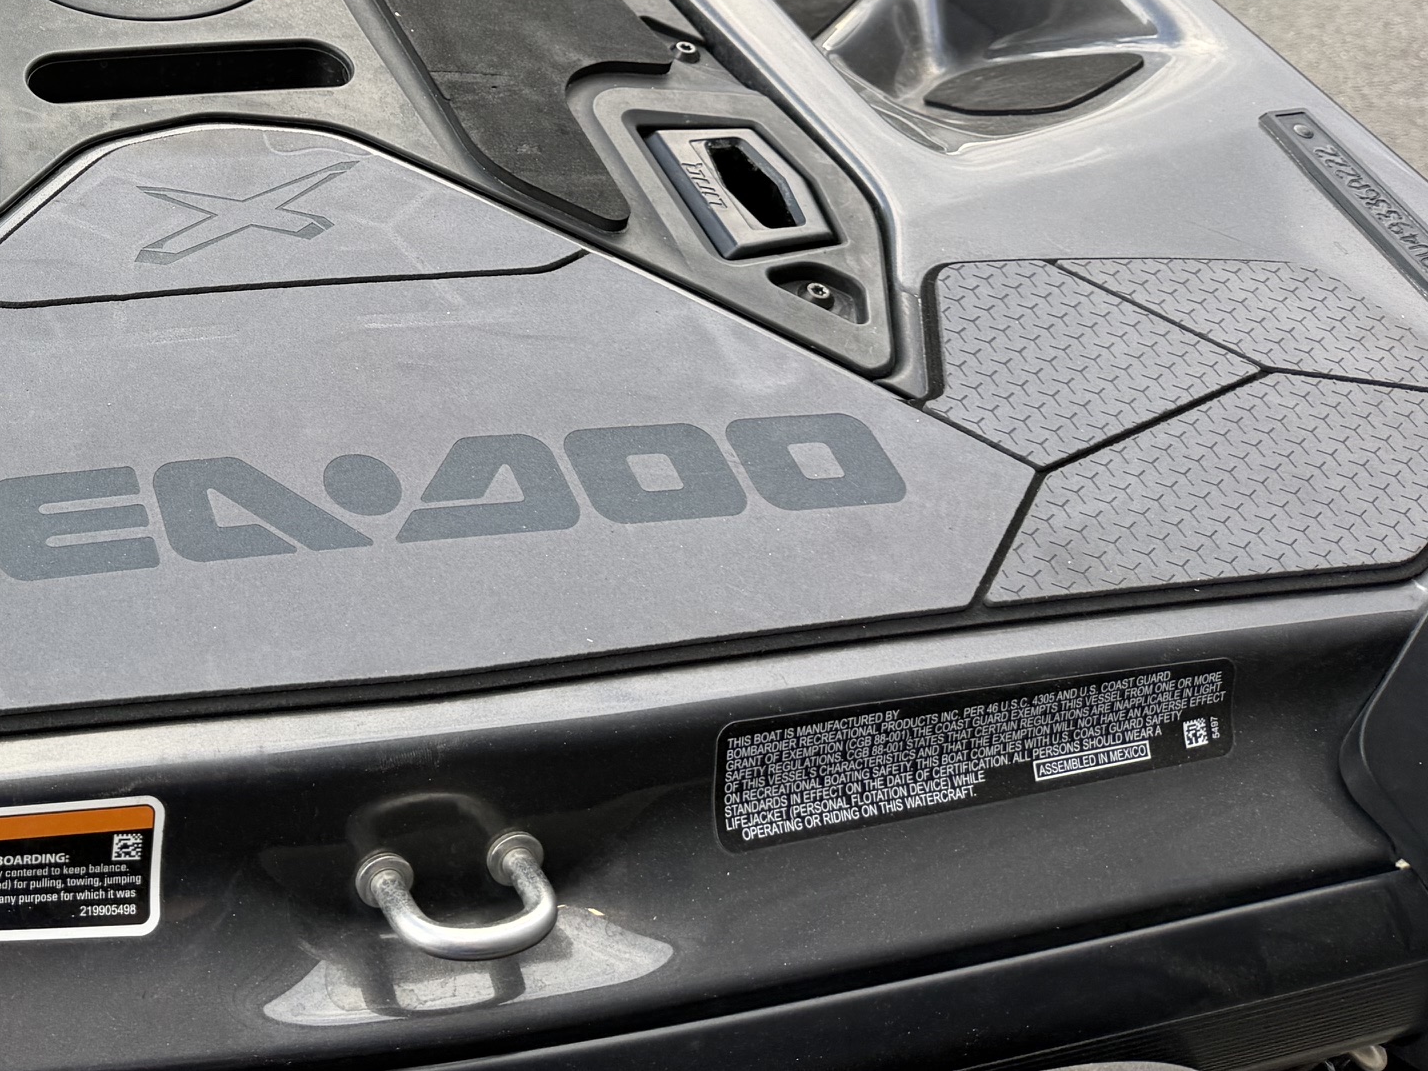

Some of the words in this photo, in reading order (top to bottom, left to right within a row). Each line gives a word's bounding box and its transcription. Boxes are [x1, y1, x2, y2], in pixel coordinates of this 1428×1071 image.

[725, 767, 766, 782] SAFETY
[768, 754, 844, 775] REGULATIONS.
[846, 748, 869, 760] CGB
[872, 741, 904, 755] 88-001
[907, 734, 944, 749] STATES
[947, 728, 971, 741] THAT
[973, 719, 1019, 736] CERTAIN
[1022, 708, 1089, 729] REGULATIONS
[1090, 703, 1111, 714] ARE
[1113, 688, 1181, 711] INAPPLICABLE
[1183, 687, 1192, 697] IN
[1194, 682, 1222, 695] LIGHT
[727, 740, 796, 760] BOMBARDIER
[799, 723, 878, 747] RECREATIONAL
[881, 713, 939, 733] PRODUCTS
[941, 710, 960, 722] INC.
[964, 705, 984, 717] PER
[987, 703, 998, 713] 46
[1000, 698, 1030, 711] U.S.C.
[1032, 694, 1055, 705] 4305
[1057, 688, 1078, 701] AND
[1080, 686, 1098, 697] U.S.
[1100, 677, 1136, 692] COAST
[1136, 671, 1171, 686] GUARD
[727, 735, 751, 748] THIS
[754, 730, 782, 743] BOAT
[784, 728, 794, 738] IS
[796, 712, 883, 737] MANUFACTURED
[885, 710, 900, 721] BY
[1211, 717, 1220, 738] 5497
[724, 781, 740, 793] OF
[742, 776, 765, 789] THIS
[768, 767, 817, 785] VESSEL'S
[819, 750, 916, 776] CHARACTERISTICS
[917, 745, 939, 757] AND
[942, 740, 967, 753] THAT
[970, 736, 990, 748] THE
[992, 723, 1052, 744] EXEMPTION
[1052, 719, 1075, 732] WILL
[1078, 715, 1099, 728] NOT
[1101, 709, 1126, 723] HAVE
[1128, 706, 1141, 717] AN
[1142, 697, 1188, 716] ADVERSE
[1190, 691, 1226, 707] EFFECT
[724, 794, 740, 805] ON
[743, 778, 820, 801] RECREATIONAL
[824, 769, 870, 786] BOATING
[872, 762, 914, 777] SAFETY.
[916, 756, 939, 769] THIS
[942, 749, 970, 763] BOAT
[971, 740, 1022, 759] COMPLIES
[1024, 734, 1050, 749] WITH
[1052, 731, 1071, 743] U.S.
[1074, 723, 1109, 739] COAST
[1110, 717, 1144, 733] GUARD
[1145, 711, 1183, 726] SAFETY
[1039, 754, 1096, 776] ASSEMBLED
[1098, 752, 1109, 764] IN
[1110, 745, 1146, 761] MEXICO
[724, 797, 788, 818] STANDARDS
[790, 794, 801, 804] IN
[803, 784, 844, 803] EFFECT
[846, 783, 861, 794] ON
[864, 777, 885, 791] THE
[886, 771, 913, 787] DATE
[915, 768, 931, 780] OF
[932, 757, 1011, 778] CERTIFICATION.
[1013, 751, 1031, 763] ALL
[1033, 740, 1080, 759] PERSONS
[1083, 733, 1123, 750] SHOULD
[1124, 727, 1154, 740] WEAR
[1153, 726, 1162, 737] A
[742, 819, 803, 841] OPERATING
[805, 815, 821, 828] OR
[824, 807, 860, 824] RIDING
[862, 804, 878, 817] ON
[879, 800, 904, 813] THIS
[905, 786, 976, 808] WATERCRAFT.
[5, 867, 48, 878] centered
[63, 865, 86, 876] keep
[89, 863, 129, 873] balance.
[14, 880, 27, 888] for
[30, 877, 64, 889] pulling,
[67, 875, 102, 887] towing,
[104, 875, 141, 885] jumping
[0, 894, 16, 905] any
[18, 891, 57, 904] purpose
[61, 891, 74, 901] for
[76, 889, 105, 900] which
[107, 889, 114, 898] it
[116, 888, 136, 898] was
[80, 904, 136, 916] 219905498
